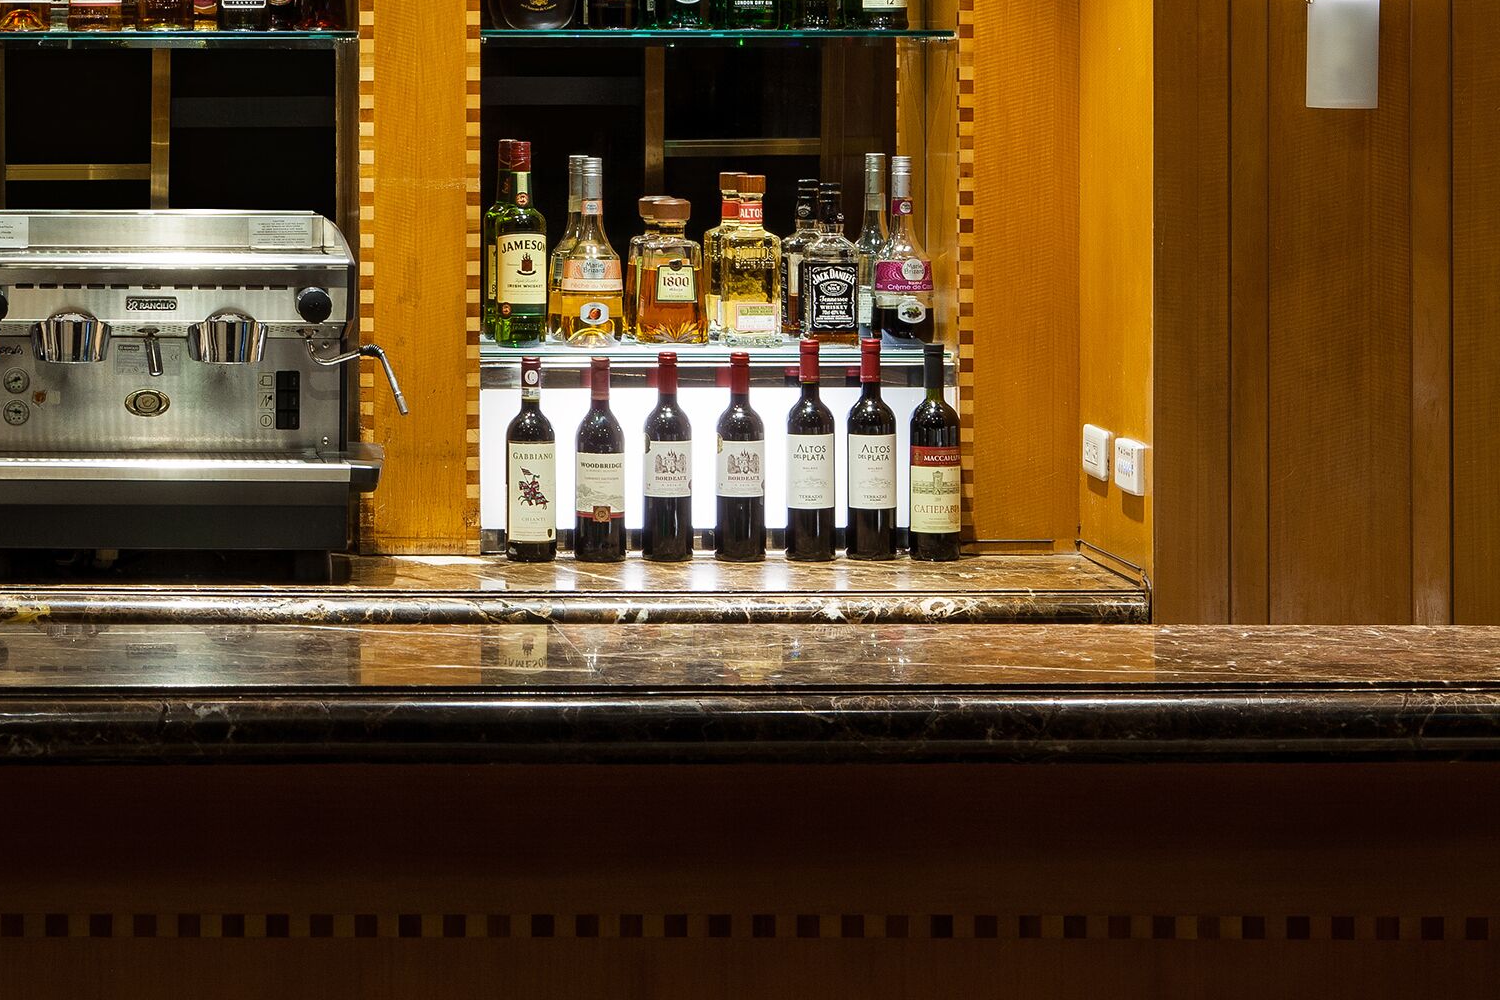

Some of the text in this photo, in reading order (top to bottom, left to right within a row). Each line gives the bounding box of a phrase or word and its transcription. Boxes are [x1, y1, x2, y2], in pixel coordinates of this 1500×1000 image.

[740, 207, 763, 219] ALTOS
[585, 261, 604, 269] Marie
[906, 262, 922, 270] Marie
[583, 267, 606, 275] Brizard
[812, 268, 856, 284] JACK DANIEL'S
[663, 276, 690, 287] 1800
[887, 283, 909, 291] Crème
[139, 302, 176, 310] RANCILIO
[796, 443, 827, 453] ALTOS
[860, 443, 891, 453] ALTOS
[512, 451, 553, 461] GABBIANO
[802, 453, 826, 461] PLATA
[867, 453, 890, 461] PLATA
